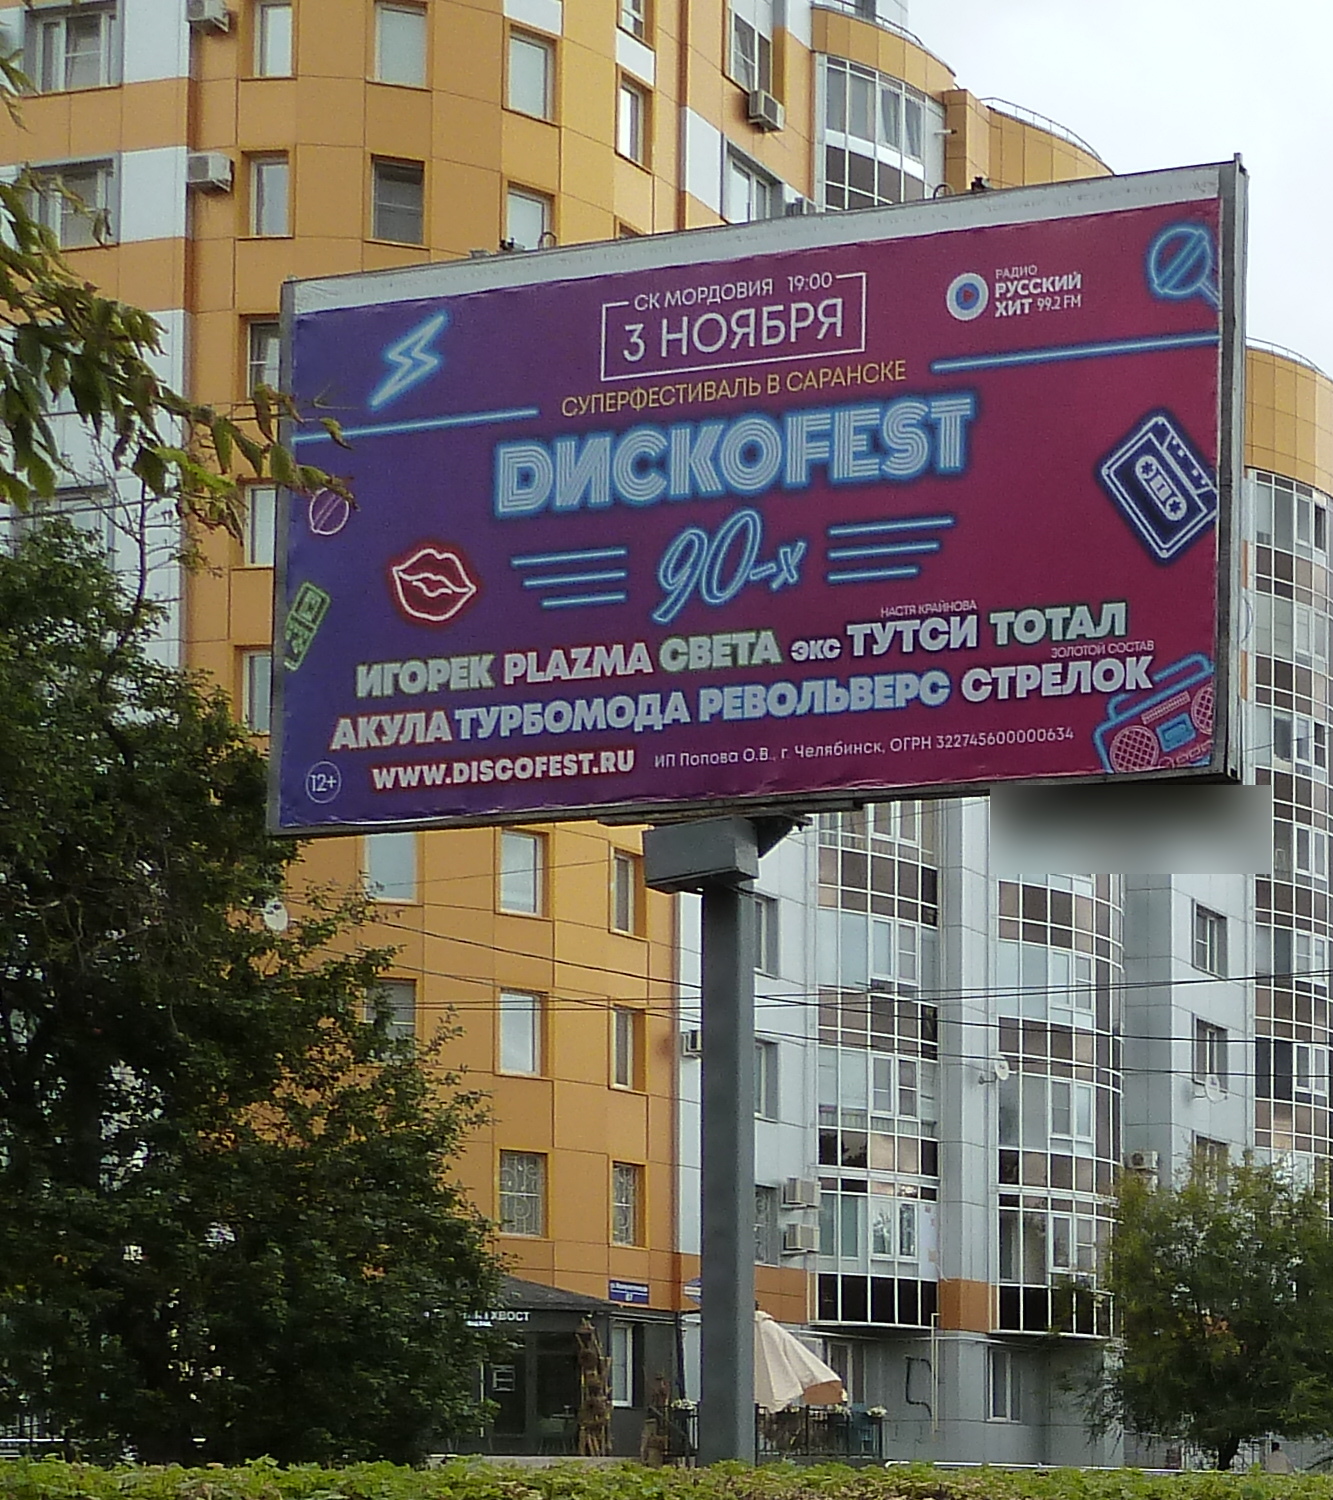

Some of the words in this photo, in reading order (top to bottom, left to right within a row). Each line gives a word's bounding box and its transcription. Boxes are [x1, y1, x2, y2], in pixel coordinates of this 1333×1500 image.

[995, 264, 1037, 279] РАДИО
[995, 271, 1082, 298] РУССКИЙ
[634, 289, 660, 311] СК
[664, 278, 773, 307] МОРДОВИЯ
[787, 272, 832, 292] 19:00
[995, 298, 1033, 318] ХИТ
[1037, 296, 1061, 312] 99.2
[1063, 294, 1081, 309] FM
[623, 324, 645, 363] 3
[661, 298, 843, 358] НОЯБРЯ
[561, 376, 761, 418] СУПЕРФЕСТИВАЛЬ
[767, 374, 780, 394] В
[786, 360, 906, 392] САРАНСКЕ
[881, 605, 915, 618] НАСТЯ
[918, 600, 977, 616] КРАЙНОВА
[355, 654, 496, 698] ИГОРЕК
[504, 642, 654, 685] PLAZMA
[659, 630, 782, 673] СВЕТА
[847, 614, 978, 657] ТУТСИ
[989, 602, 1127, 646] ТОТАЛ
[1050, 644, 1105, 659] ЗОЛОТОЙ
[1108, 640, 1154, 655] СОСТАВ
[330, 709, 453, 750] АКУЛА
[454, 692, 692, 741] ТУРБОМОДА
[698, 670, 951, 723] РЕВОЛЬВЕРС
[961, 655, 1154, 703] СТРЕЛОК
[654, 754, 676, 769] ИП
[680, 752, 738, 767] Попова
[794, 740, 886, 759] Челябинск,
[890, 735, 932, 752] ОГРН
[309, 773, 338, 793] 12+
[372, 749, 636, 791] WWW.DISCOFEST.RU
